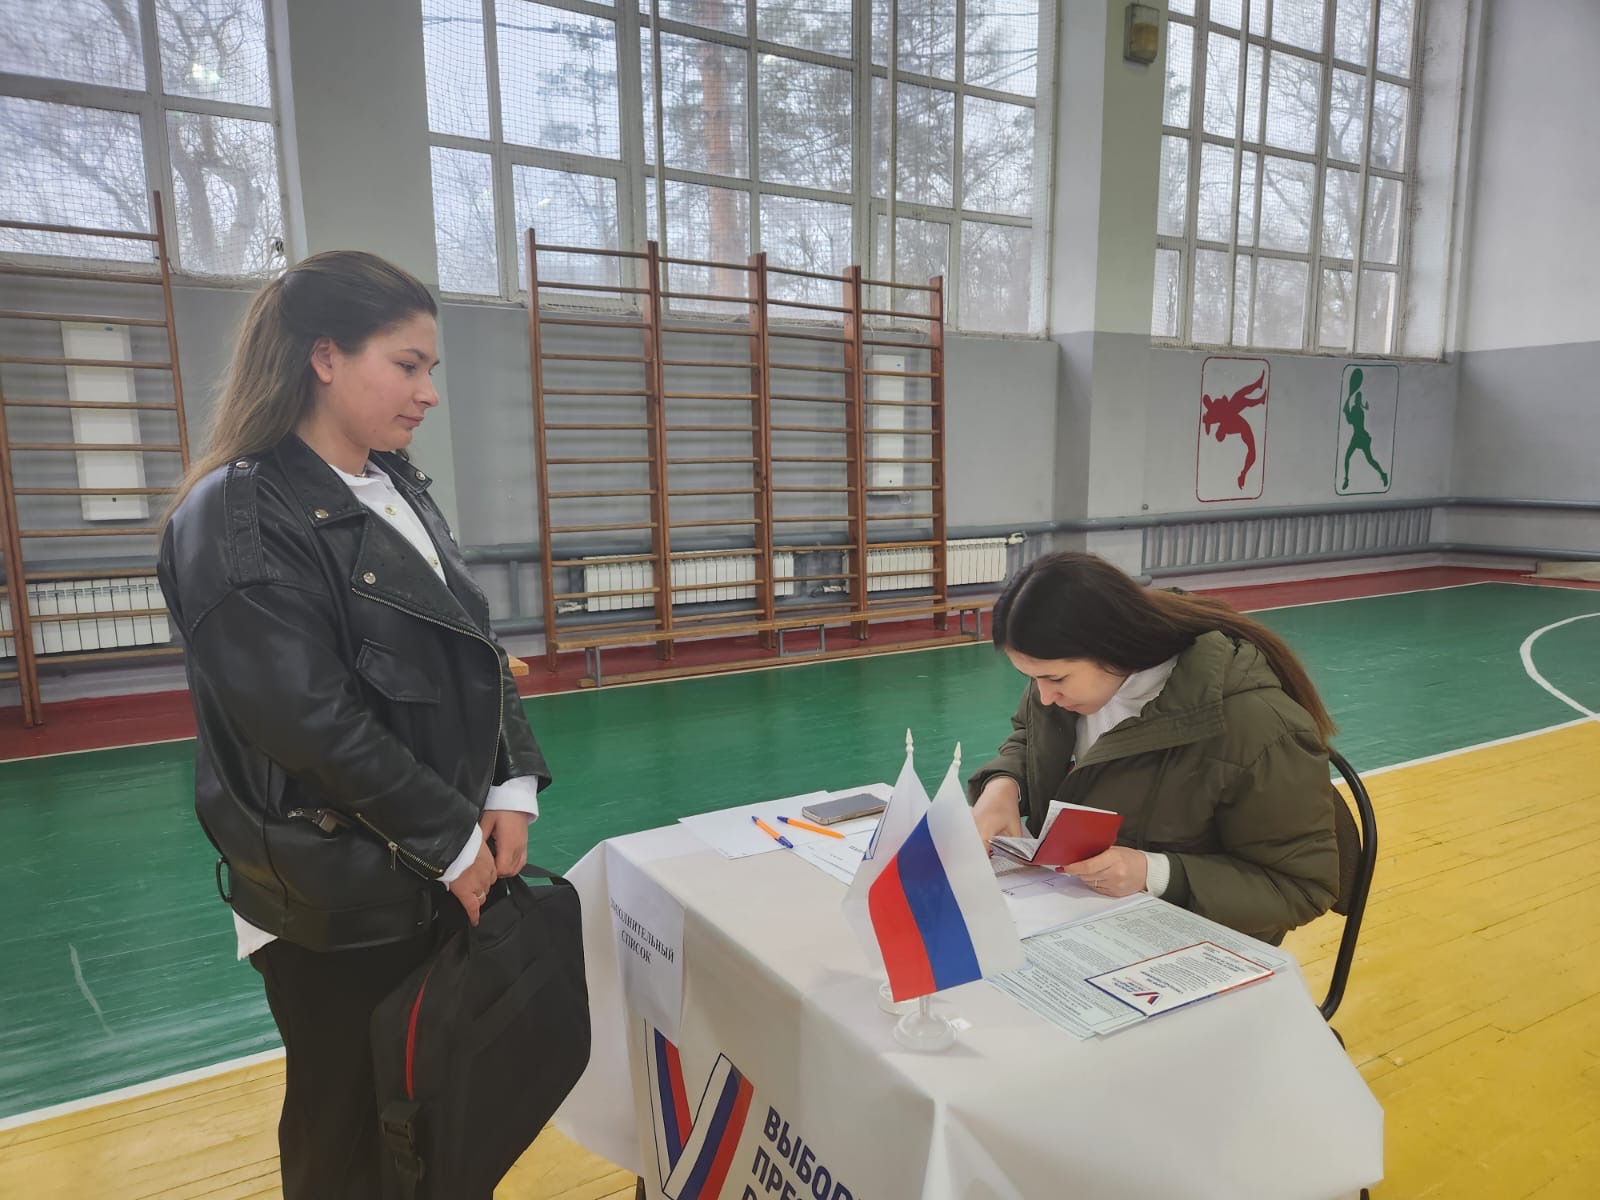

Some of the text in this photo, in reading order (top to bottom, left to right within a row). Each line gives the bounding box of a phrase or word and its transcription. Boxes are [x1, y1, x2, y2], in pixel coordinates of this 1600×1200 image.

[610, 897, 674, 964] ПОЛНИТЕЛЬНЫЙ
[619, 929, 652, 964] СПИСОК
[751, 1145, 803, 1200] ПРЕ
[763, 1105, 861, 1200] ВЫБОР
